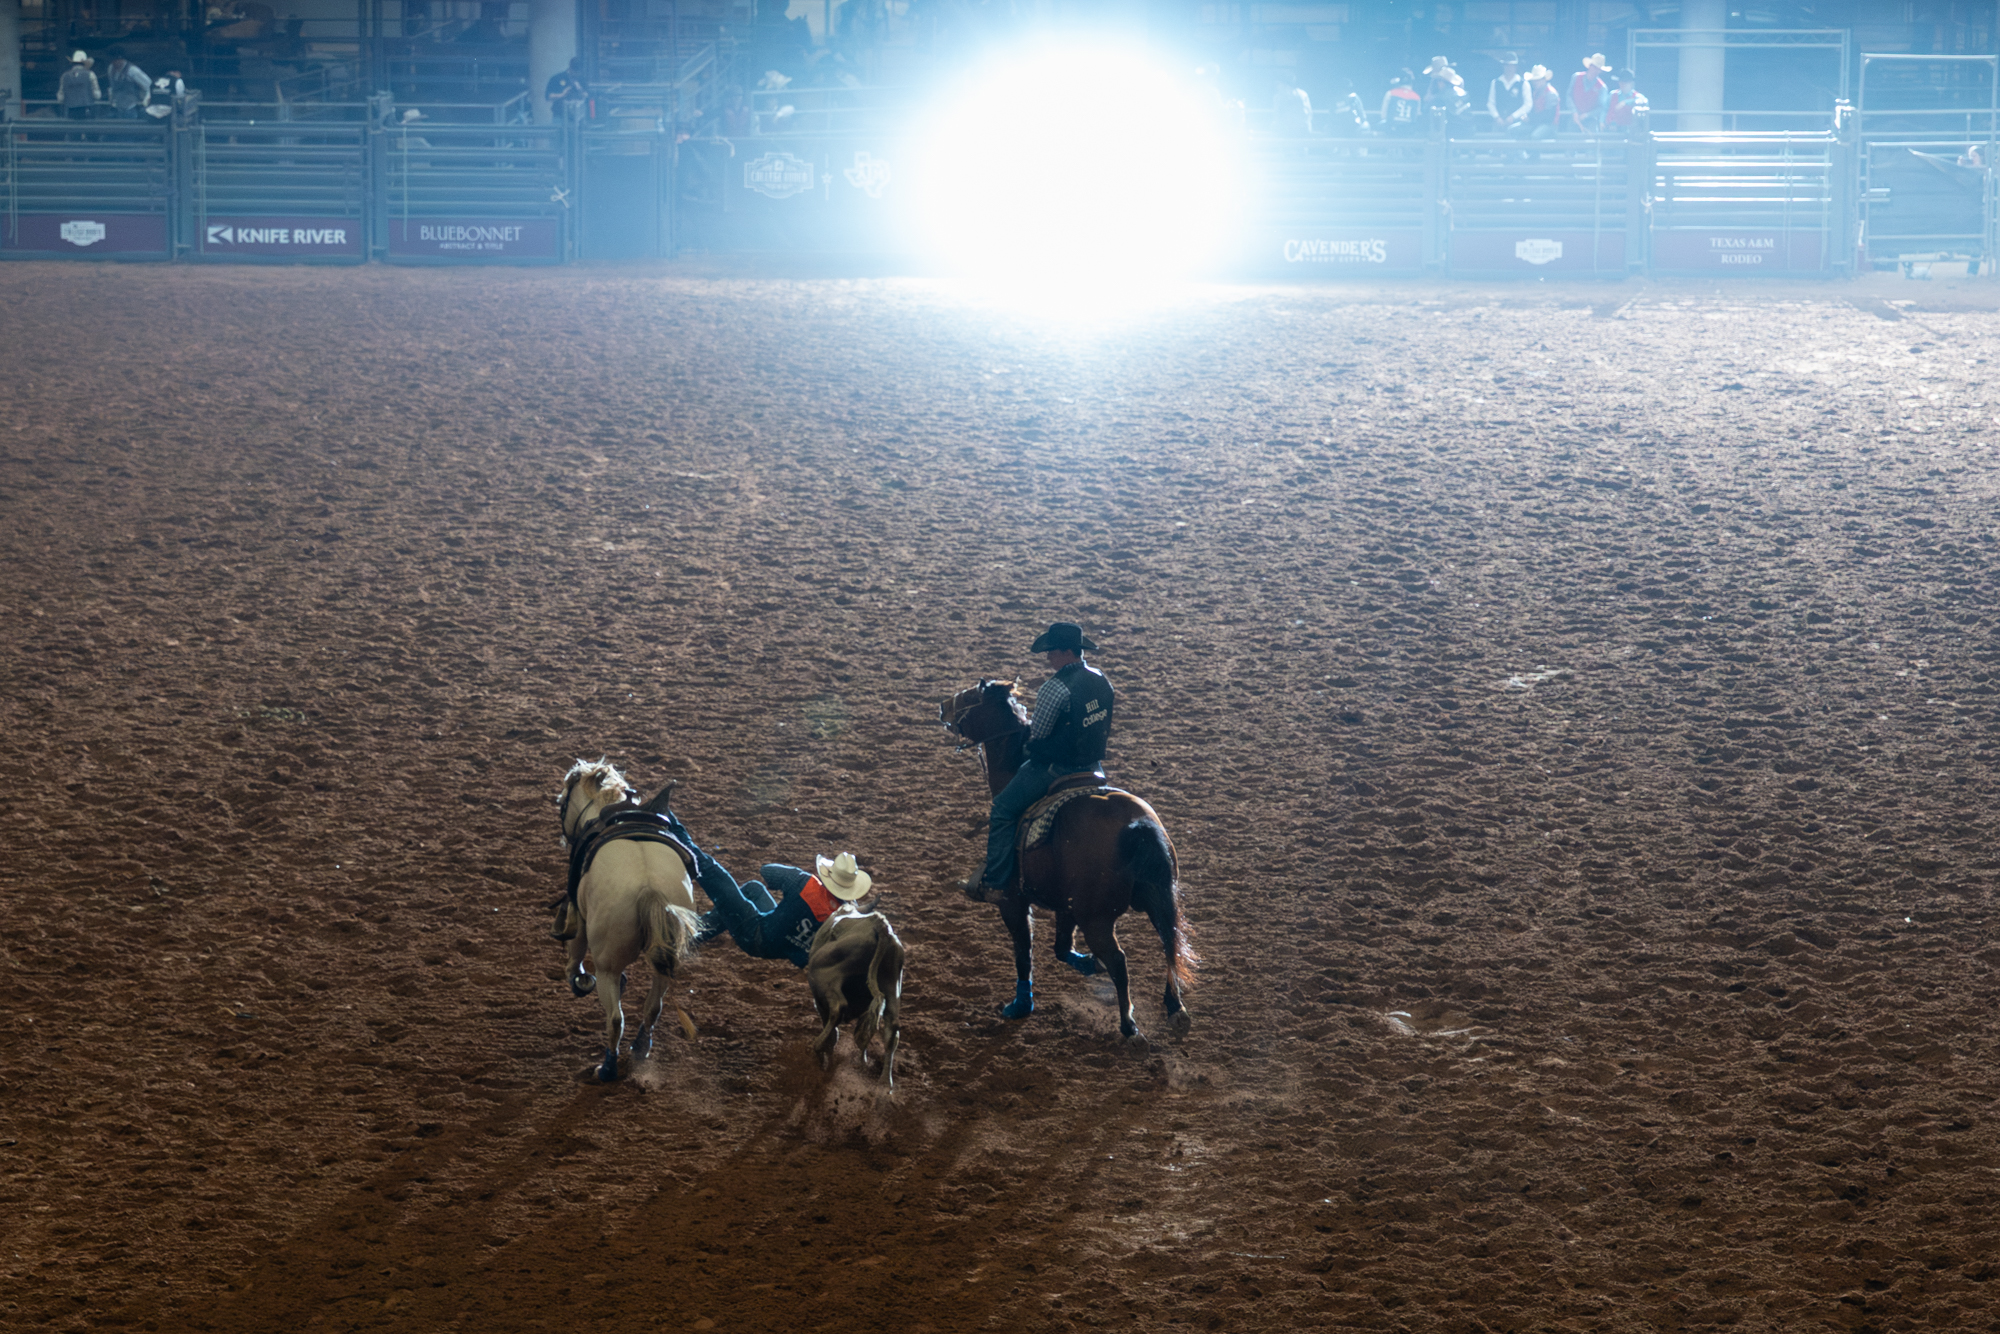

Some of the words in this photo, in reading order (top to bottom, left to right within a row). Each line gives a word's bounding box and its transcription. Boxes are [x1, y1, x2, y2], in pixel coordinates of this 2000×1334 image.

[237, 228, 290, 244] KNIFE
[293, 229, 347, 244] RIVER
[420, 225, 523, 242] BLUEBONNET
[1283, 237, 1387, 263] CAVENDER'S
[1709, 237, 1746, 248] TEXAS
[1747, 238, 1774, 248] A&M
[1721, 253, 1762, 265] RODEO
[1085, 698, 1100, 714] Hill
[1082, 708, 1108, 728] College
